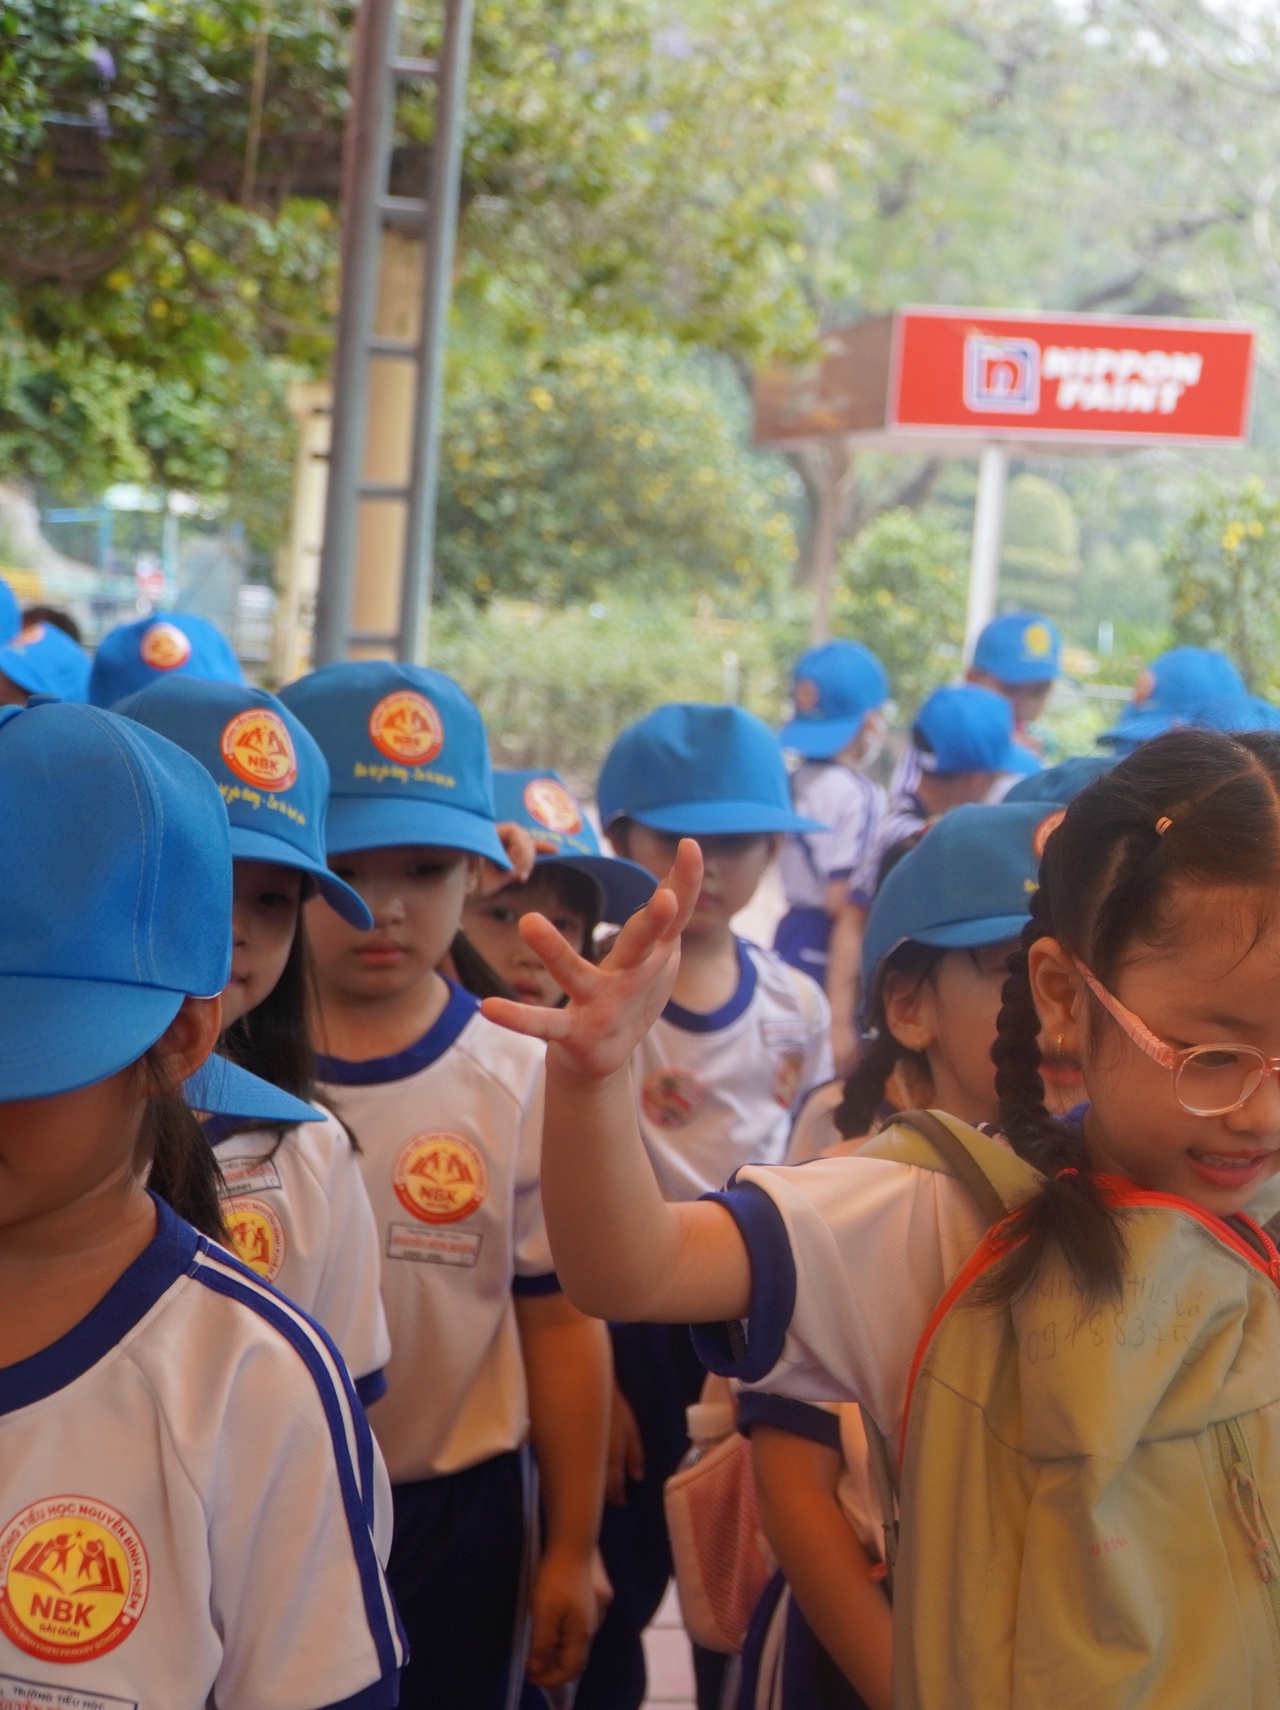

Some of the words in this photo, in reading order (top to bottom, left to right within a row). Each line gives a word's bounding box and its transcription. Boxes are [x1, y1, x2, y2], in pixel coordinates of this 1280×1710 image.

[1042, 346, 1203, 386] NIPPON
[1056, 378, 1186, 414] PAINT
[248, 755, 279, 772] NBK
[418, 1186, 456, 1204] NBK
[48, 1503, 76, 1518] HỌC
[79, 1504, 127, 1538] NGUYỄN
[29, 1593, 97, 1628] NBK
